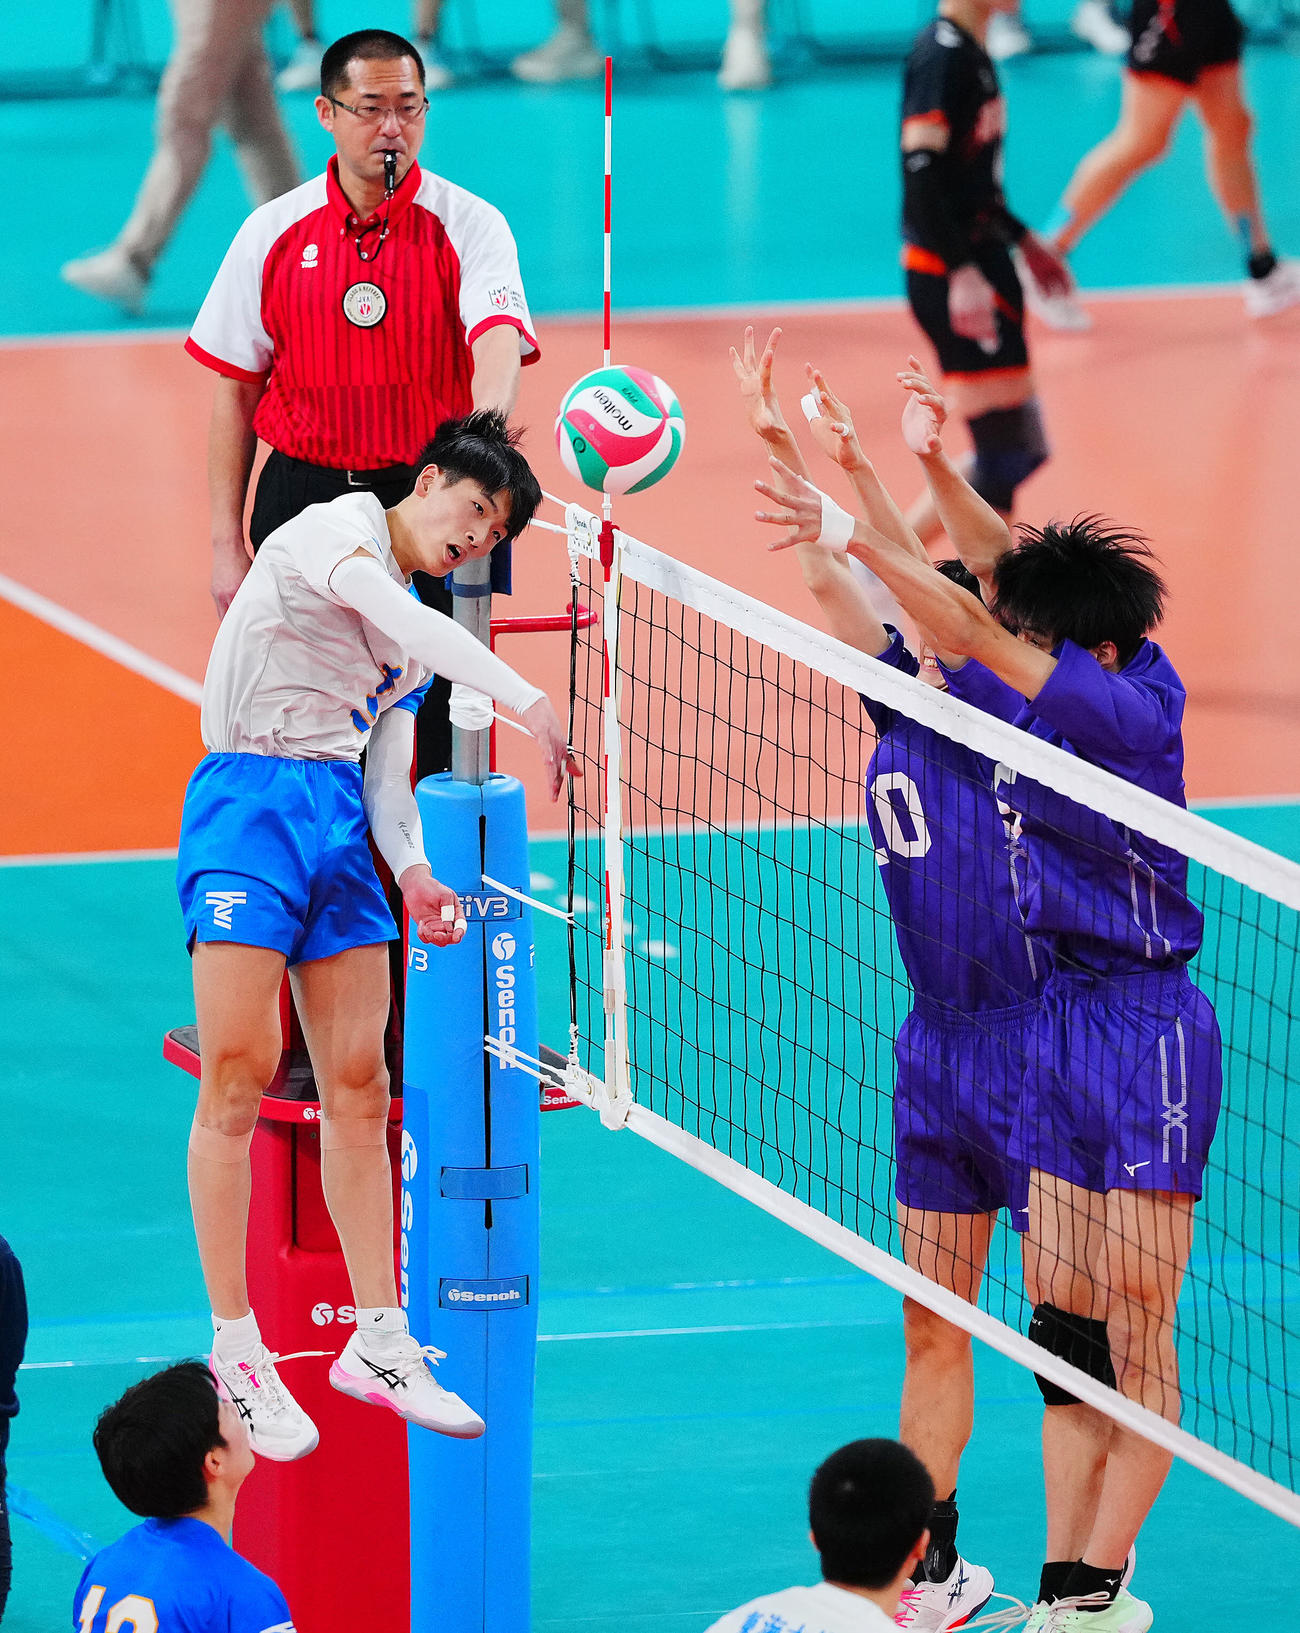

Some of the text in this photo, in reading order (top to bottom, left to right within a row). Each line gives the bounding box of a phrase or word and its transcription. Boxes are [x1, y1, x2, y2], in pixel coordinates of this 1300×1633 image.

[592, 389, 633, 431] molten
[543, 1095, 577, 1105] Seno
[460, 1289, 521, 1302] Senoh
